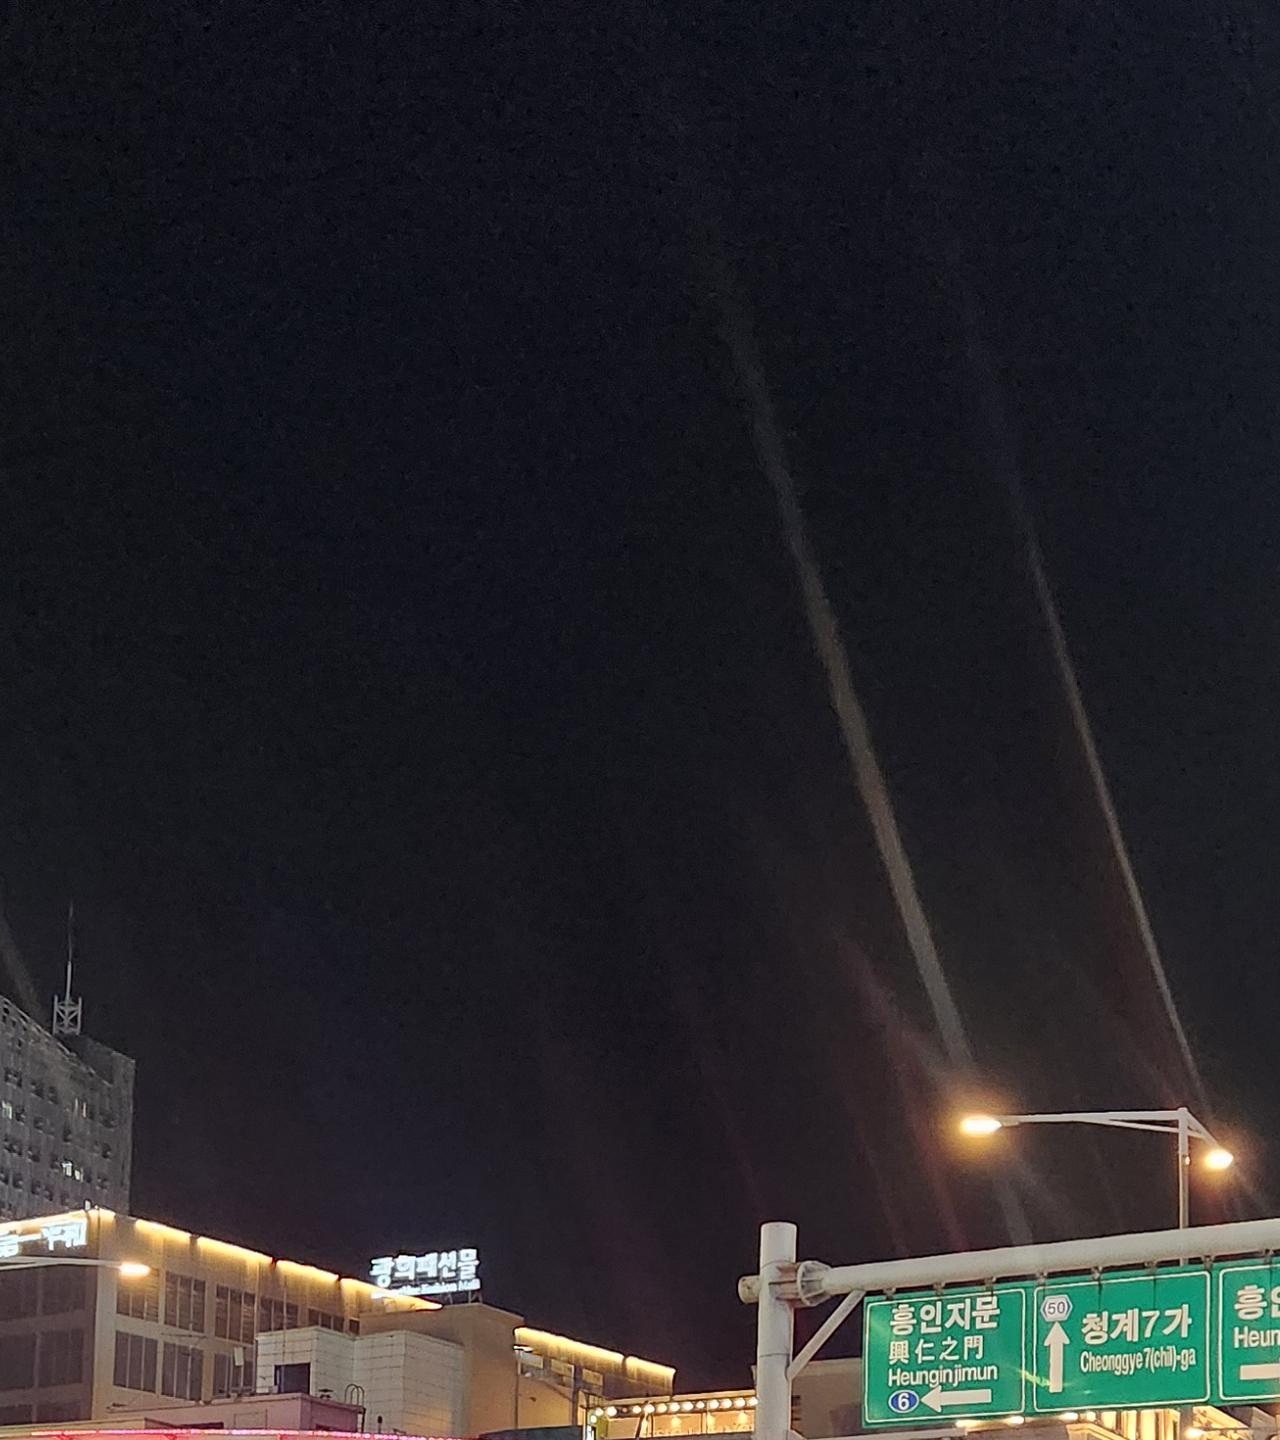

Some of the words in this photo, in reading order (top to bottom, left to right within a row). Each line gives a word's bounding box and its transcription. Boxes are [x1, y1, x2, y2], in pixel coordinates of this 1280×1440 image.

[890, 1296, 1001, 1336] 흥인지문
[1047, 1302, 1066, 1315] 50
[1081, 1304, 1192, 1345] 청계7가
[889, 1335, 983, 1365] 興仁之門
[1080, 1350, 1143, 1376] Cheonggye
[888, 1364, 998, 1387] Heunginjimun
[898, 1392, 910, 1410] 6
